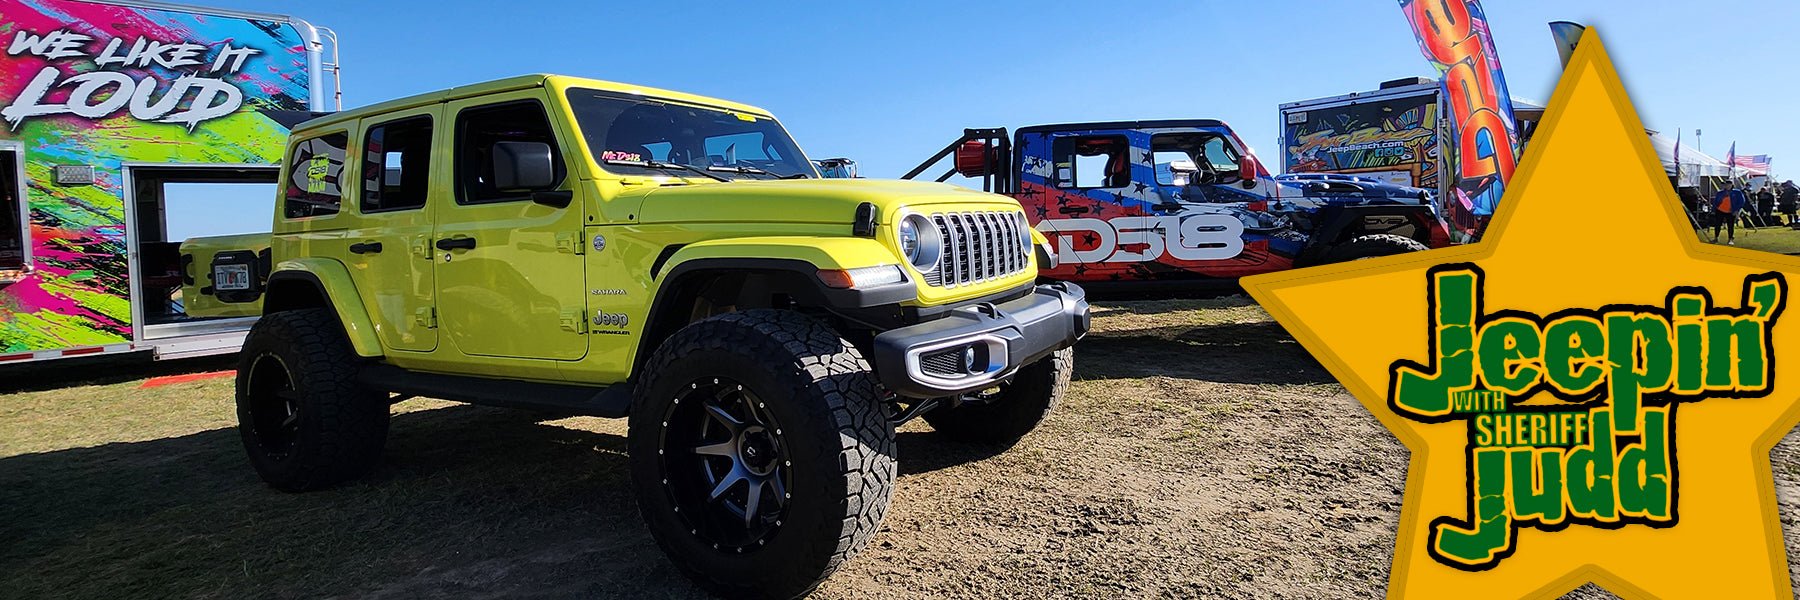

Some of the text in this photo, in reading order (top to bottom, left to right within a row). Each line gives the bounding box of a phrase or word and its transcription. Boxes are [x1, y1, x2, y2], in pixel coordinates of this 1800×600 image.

[7, 29, 262, 74] WE LIKE IT
[1, 66, 243, 133] LOUD
[1327, 140, 1404, 153] JeepBeach.com
[1034, 214, 1245, 264] DS18
[592, 308, 629, 329] Jeep
